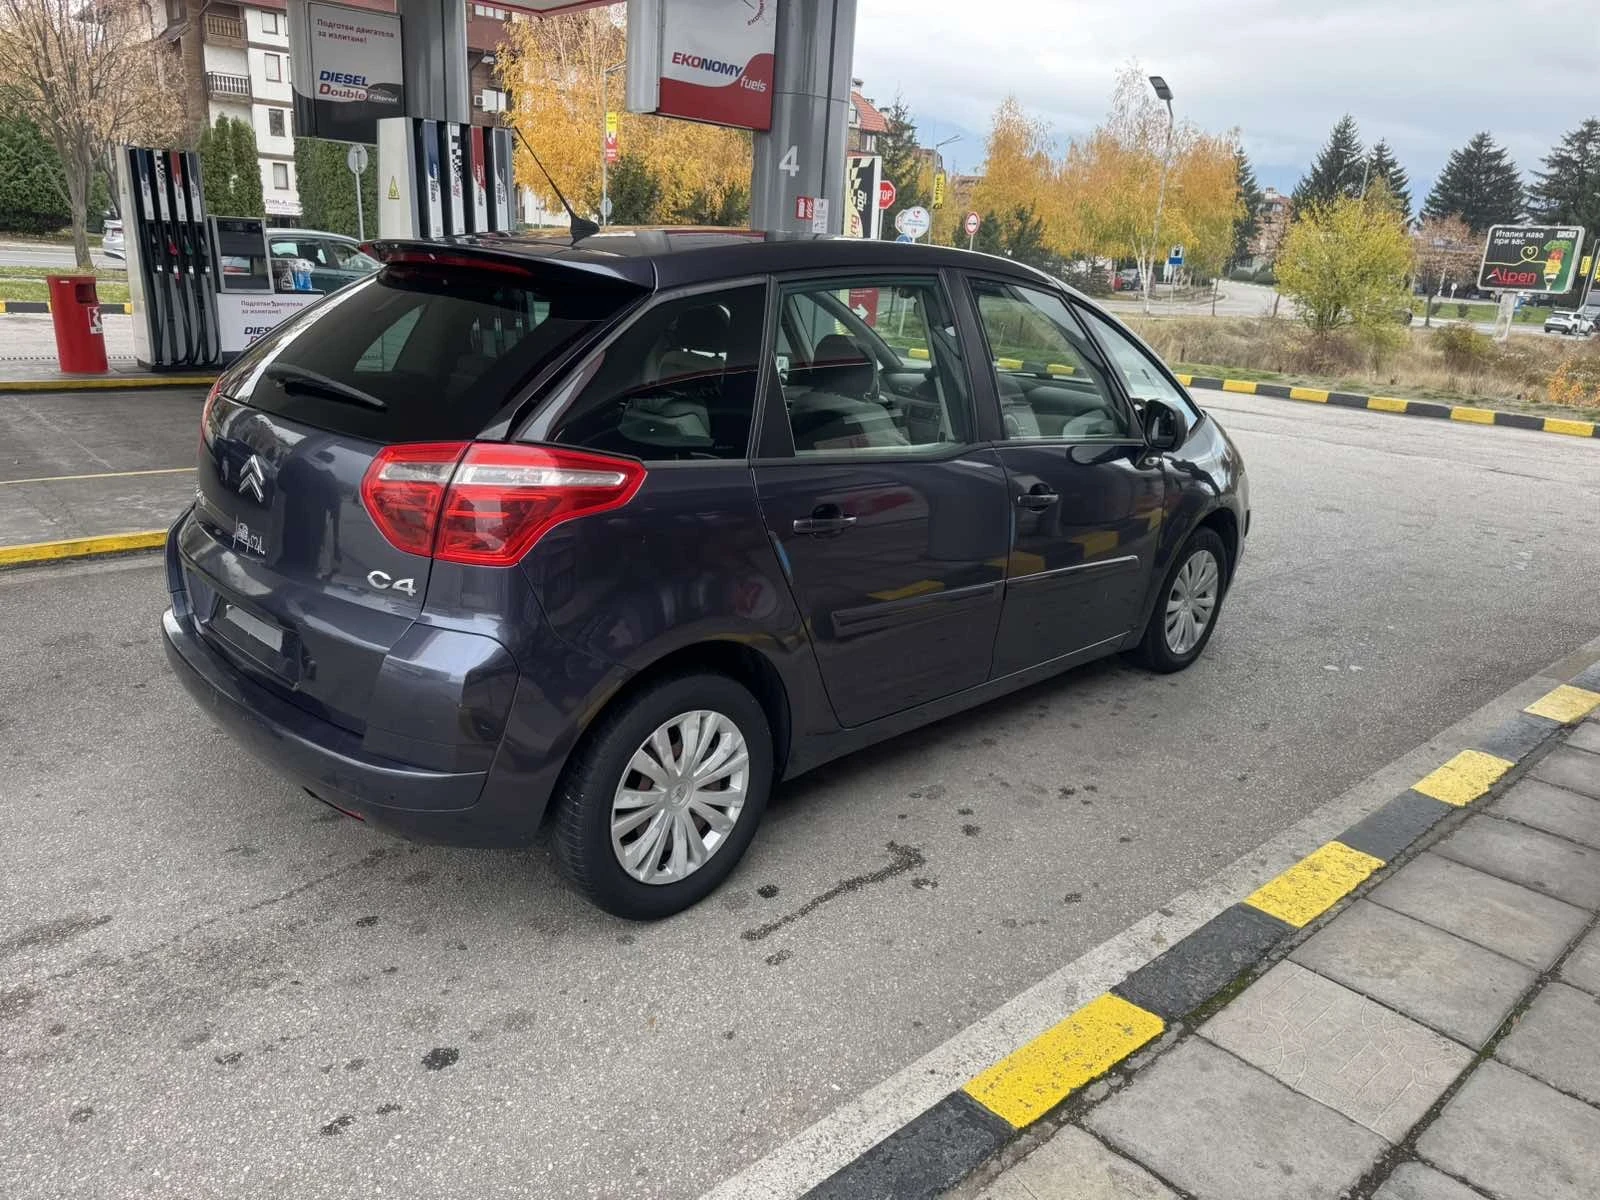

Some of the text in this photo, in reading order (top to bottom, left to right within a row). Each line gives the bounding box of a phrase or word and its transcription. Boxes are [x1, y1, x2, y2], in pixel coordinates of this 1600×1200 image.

[317, 18, 394, 38] Подготви двигателя
[328, 32, 367, 44] излитане!
[672, 52, 743, 77] EKONOMY
[319, 70, 369, 87] DIESEL
[740, 75, 767, 93] fuels
[319, 83, 367, 100] Double
[779, 145, 800, 177] 4
[857, 190, 866, 212] 100
[879, 190, 893, 200] TOP
[1494, 238, 1510, 246] при
[1496, 230, 1524, 238] Италия
[1486, 267, 1537, 284] Alpen
[244, 326, 272, 335] DIES
[367, 570, 417, 596] C4
